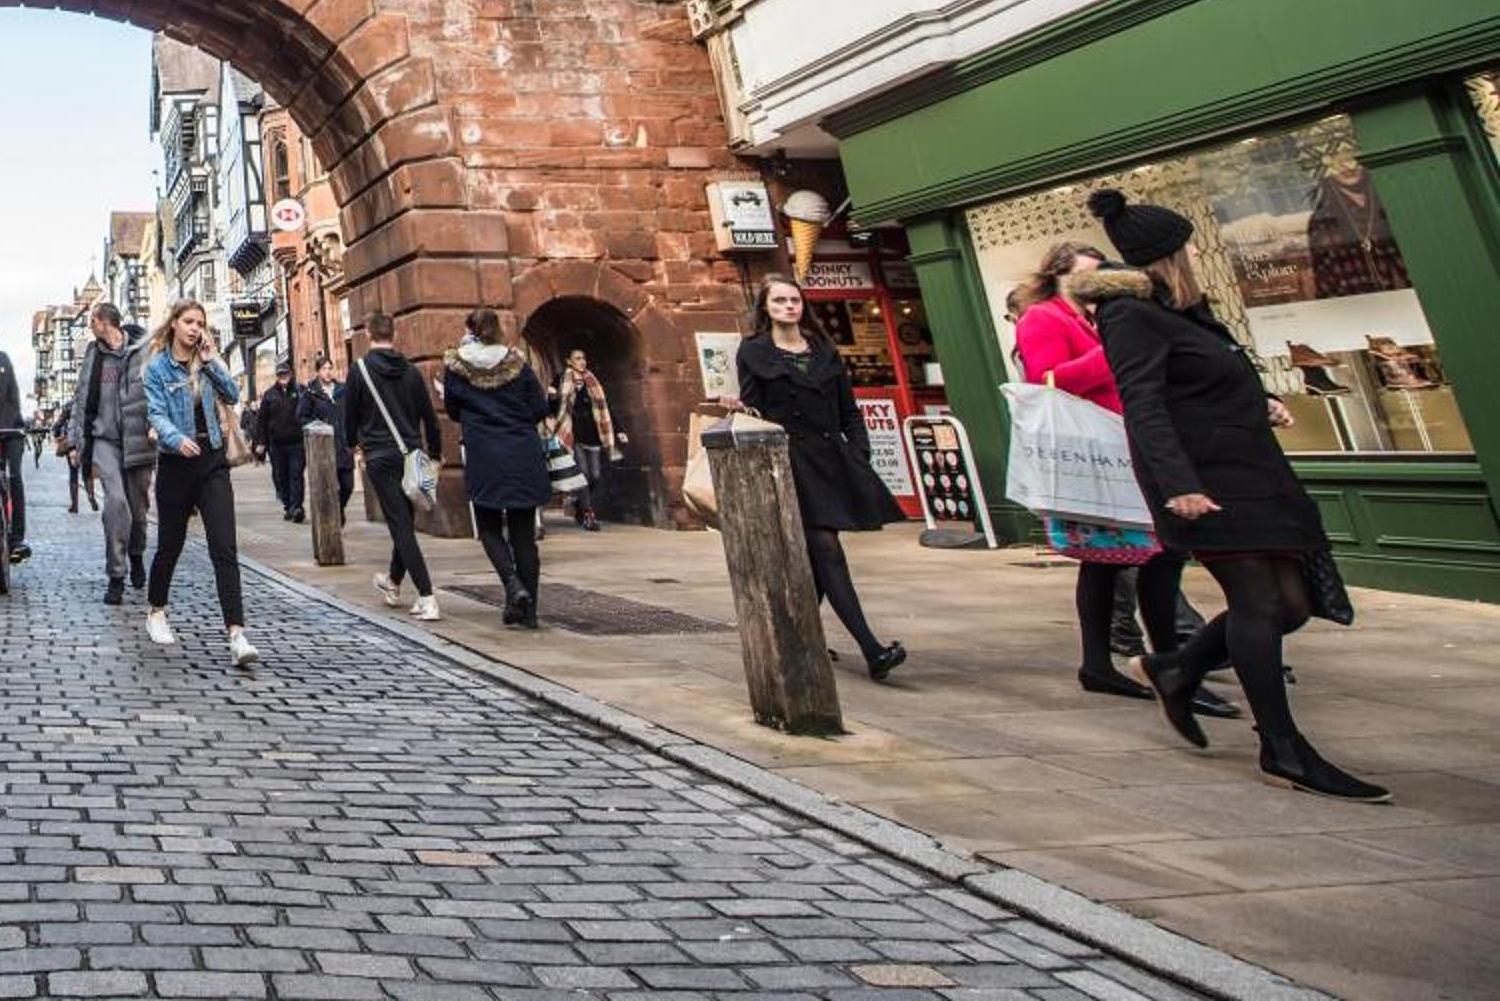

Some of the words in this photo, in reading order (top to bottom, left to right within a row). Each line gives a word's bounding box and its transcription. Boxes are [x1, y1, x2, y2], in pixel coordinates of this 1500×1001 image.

[811, 264, 852, 274] DINKY
[806, 276, 863, 287] DONUTS
[867, 419, 896, 430] UTS
